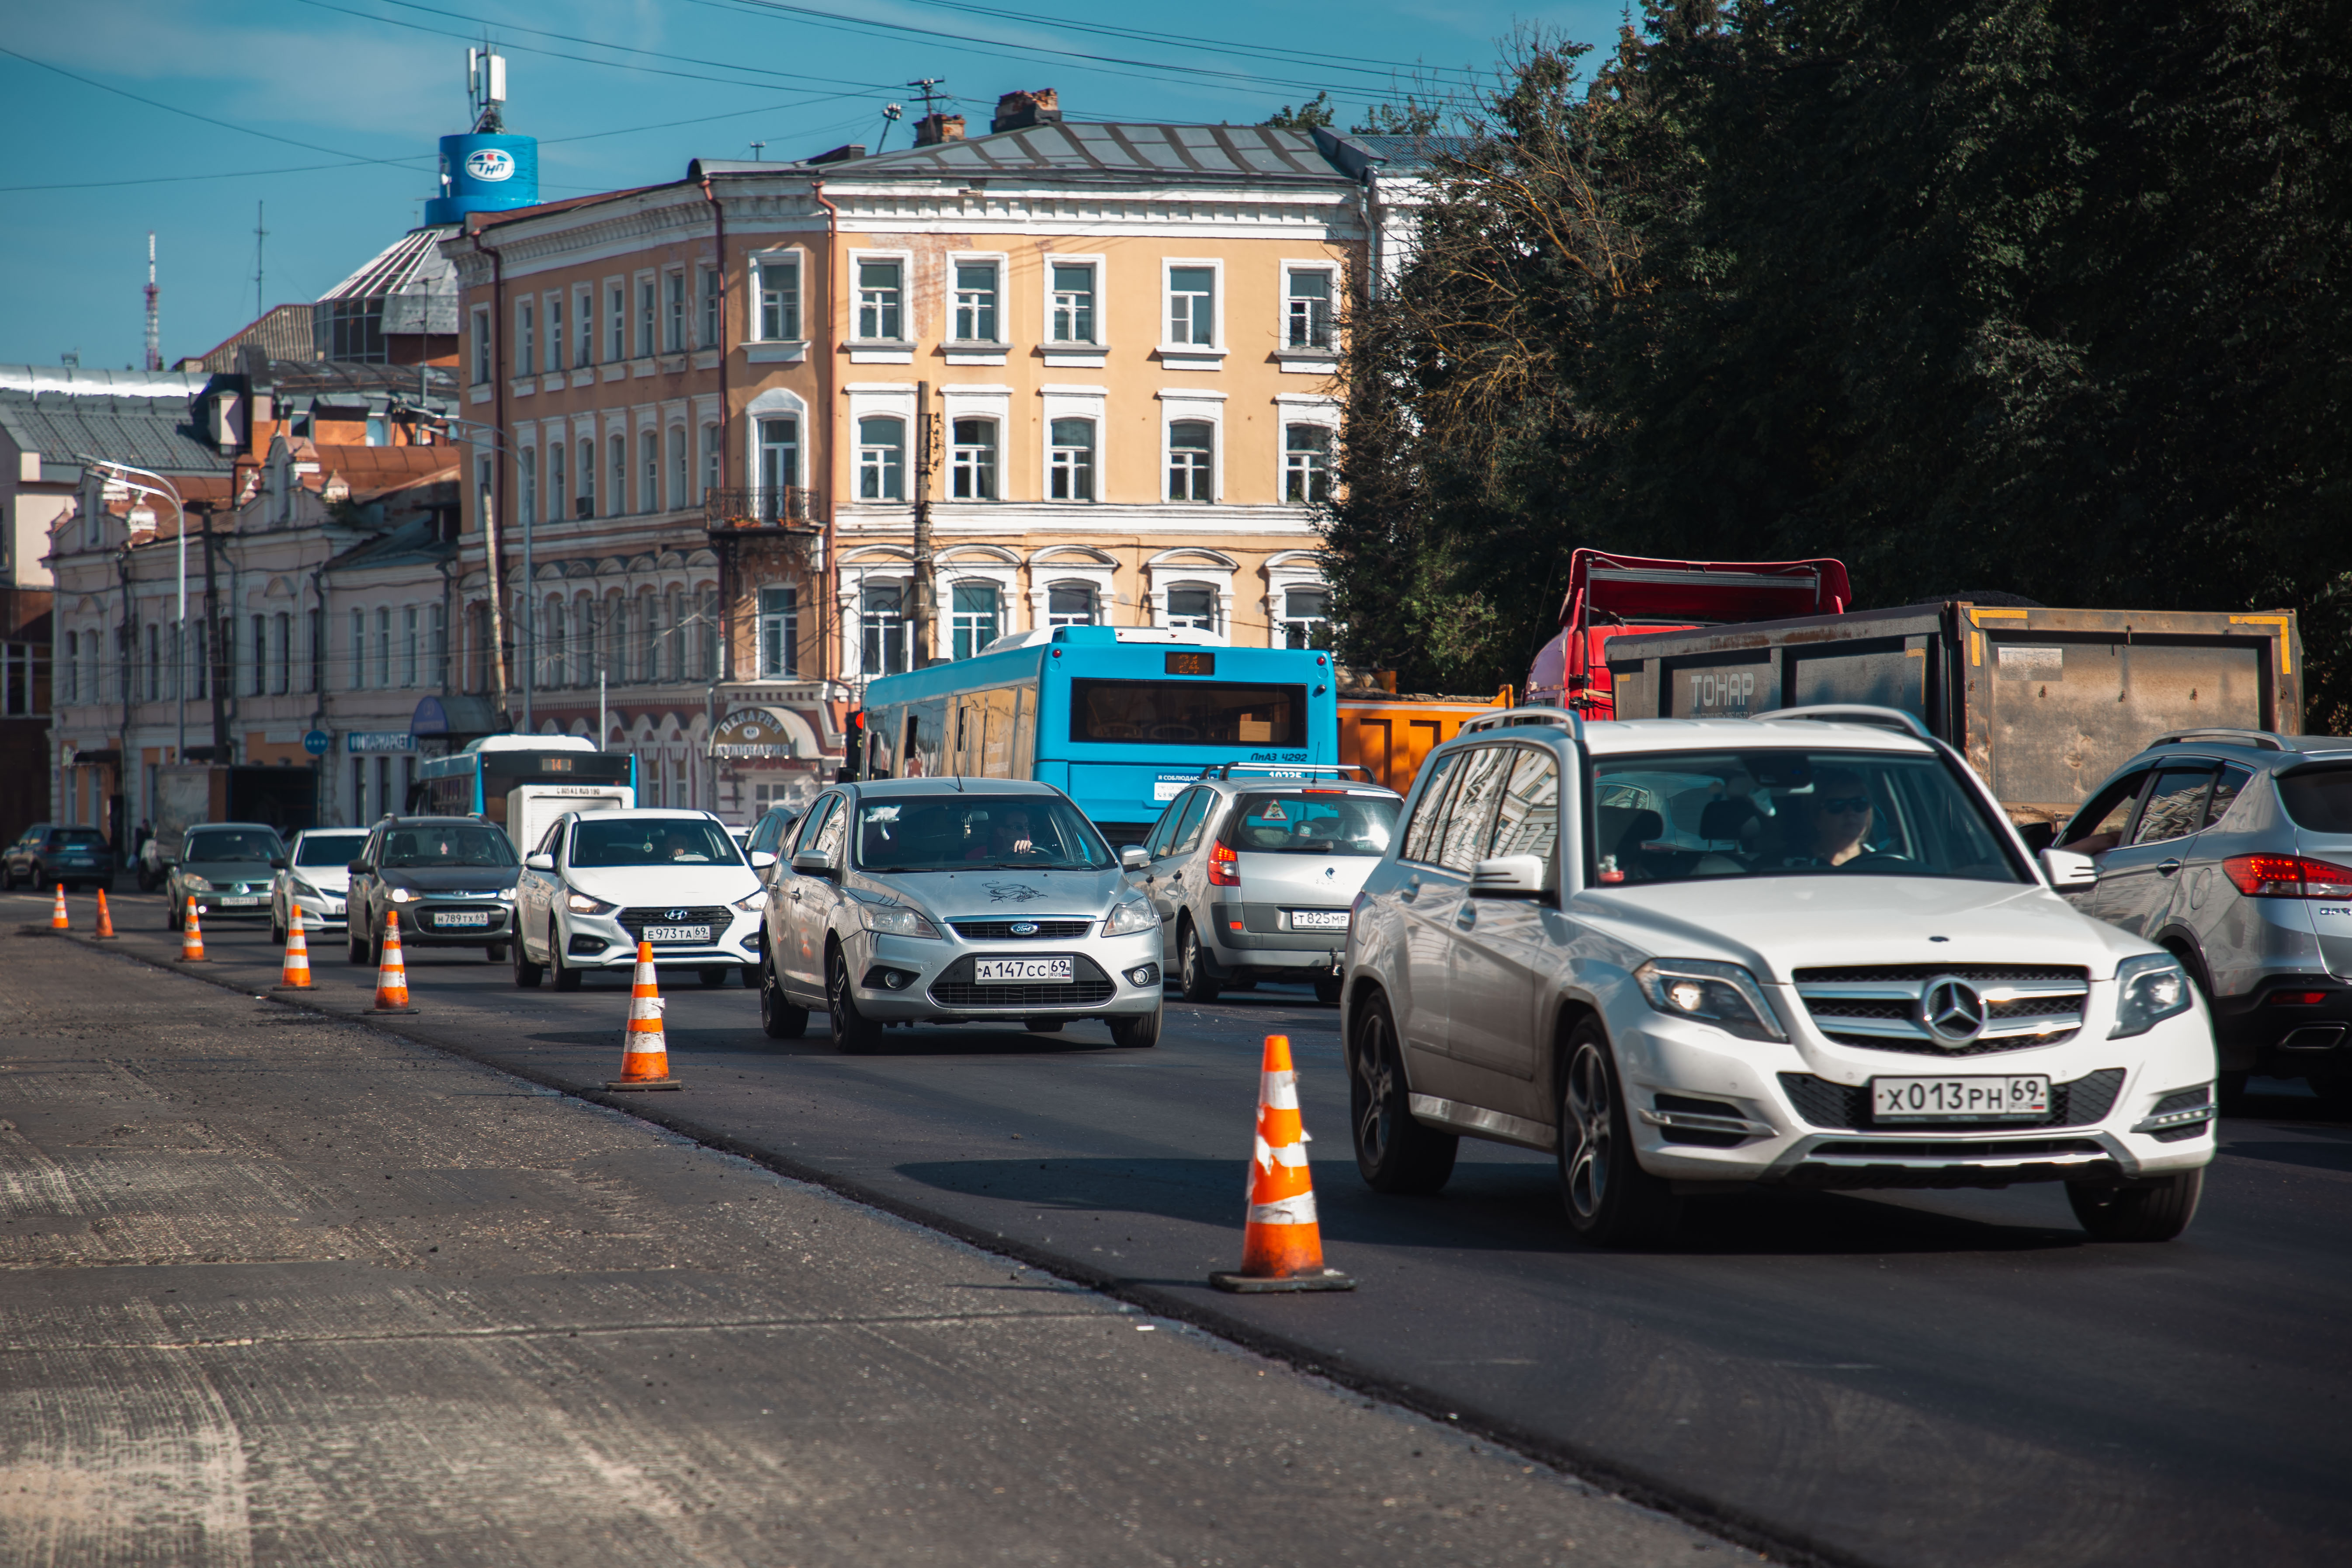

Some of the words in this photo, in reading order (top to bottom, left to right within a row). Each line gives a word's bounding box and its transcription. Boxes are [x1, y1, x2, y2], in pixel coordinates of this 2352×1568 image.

[1179, 654, 1199, 674] 24
[1691, 673, 1754, 707] ТОНАР
[720, 710, 783, 736] ПЕКАРНЯ
[715, 743, 790, 756] КУЛИНАРИЯ
[1282, 753, 1307, 762] 4292
[438, 914, 473, 923] Н789ТХ
[1298, 913, 1346, 924] Т825МР
[648, 928, 691, 939] Е973ТА
[695, 927, 706, 935] 69
[982, 962, 1046, 977] А147СС
[1051, 961, 1066, 972] 69
[1887, 1082, 2002, 1110] Х013РН
[2011, 1080, 2039, 1101] 69
